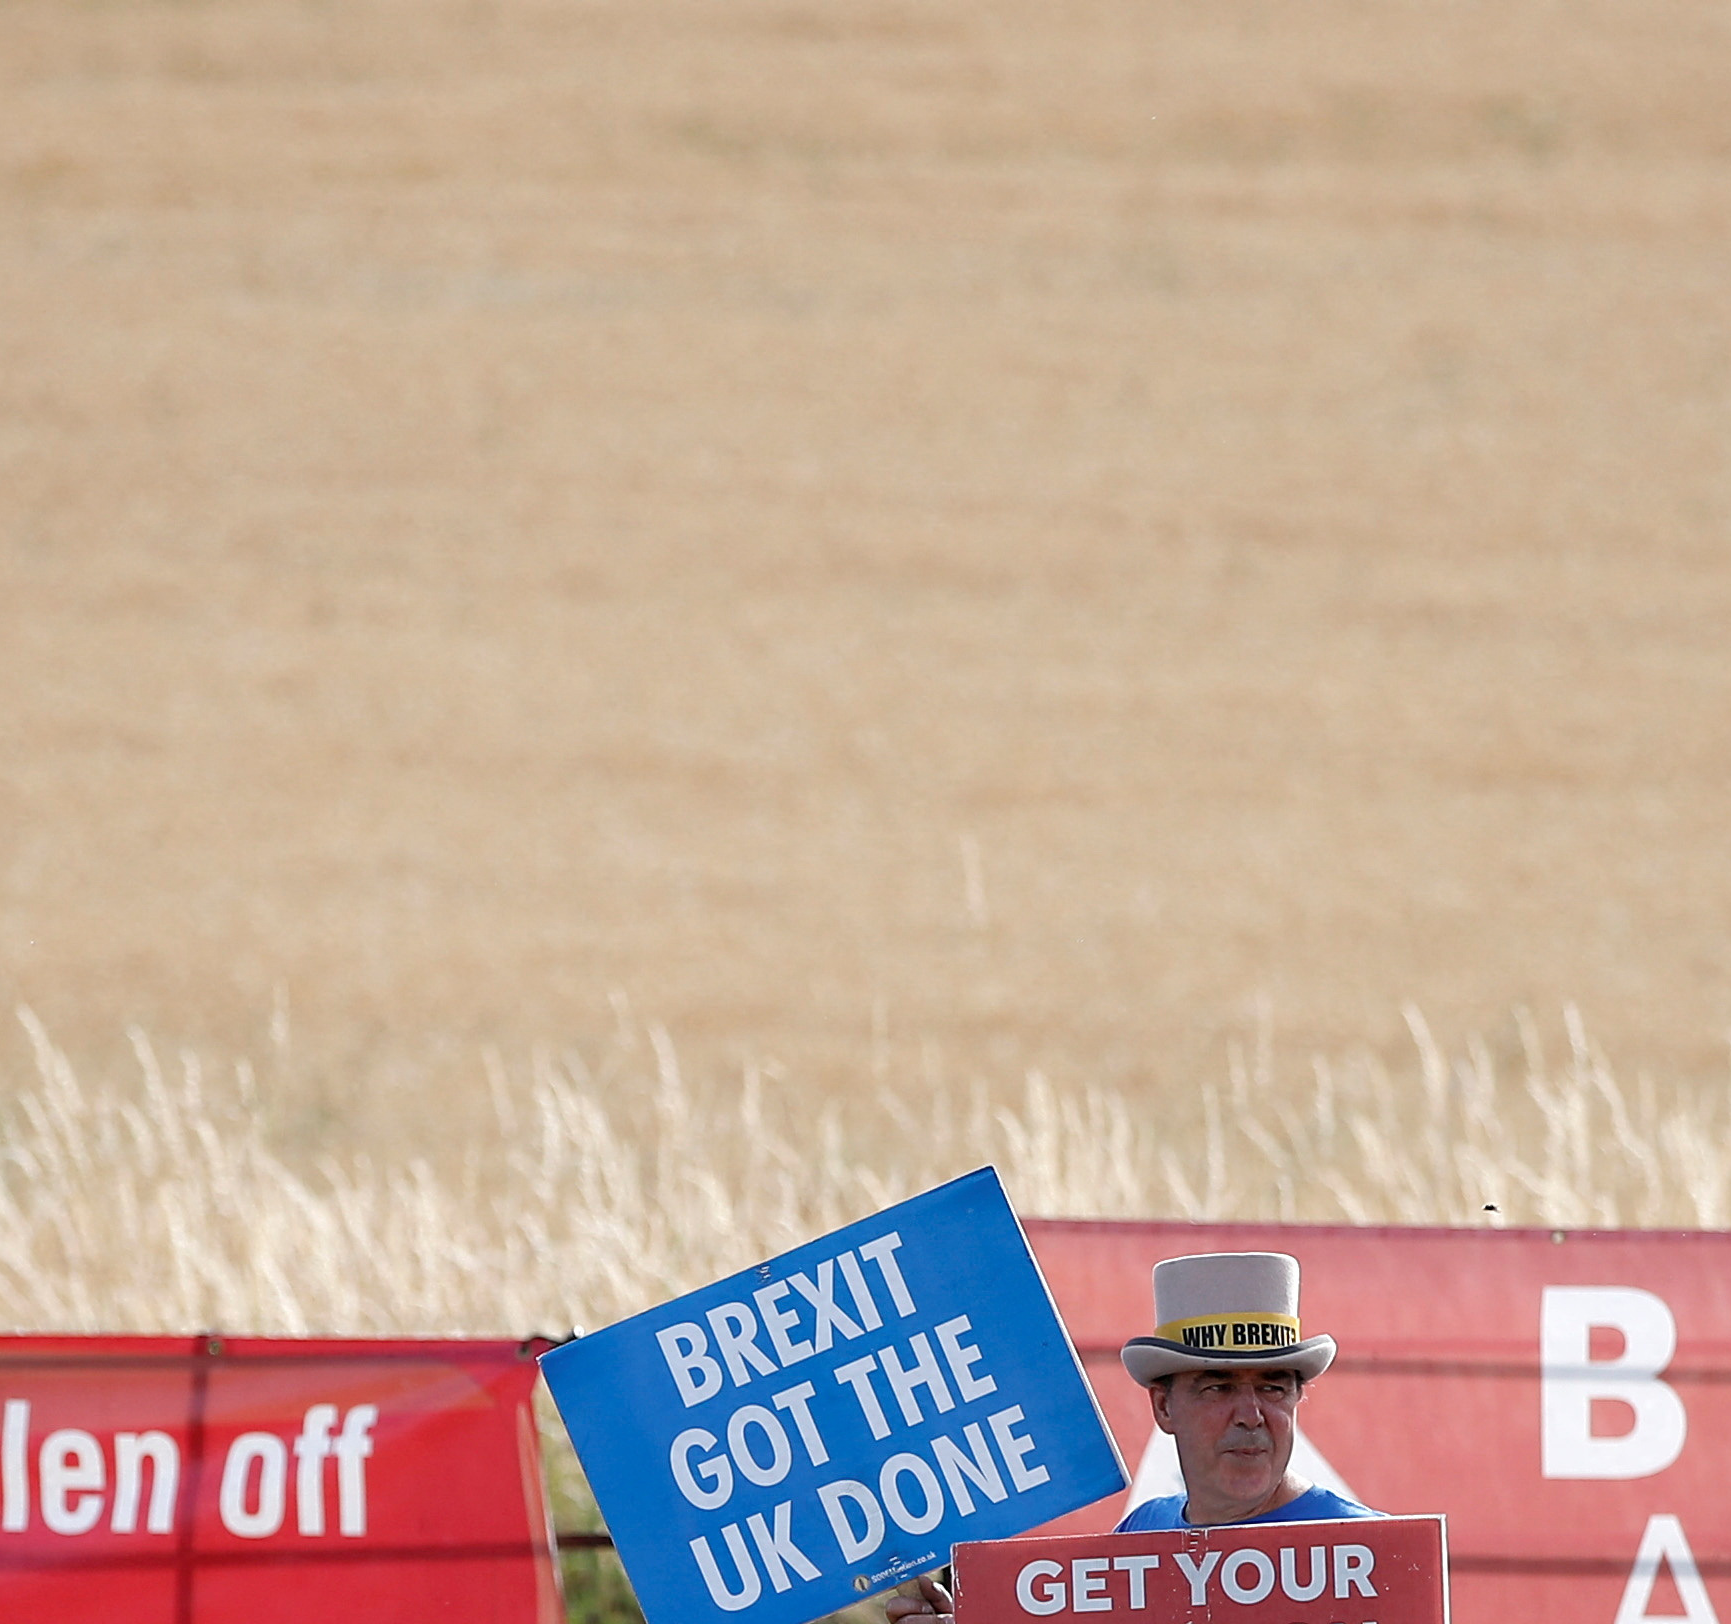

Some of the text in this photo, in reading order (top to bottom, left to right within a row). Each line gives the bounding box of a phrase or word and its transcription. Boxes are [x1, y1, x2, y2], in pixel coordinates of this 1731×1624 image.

[655, 1231, 918, 1410] BREXIT
[1182, 1323, 1227, 1348] WHY
[219, 1404, 379, 1537] off
[670, 1313, 998, 1511] GOT THE
[690, 1402, 1052, 1612] UK DONE
[1016, 1544, 1378, 1616] GET YOUR
